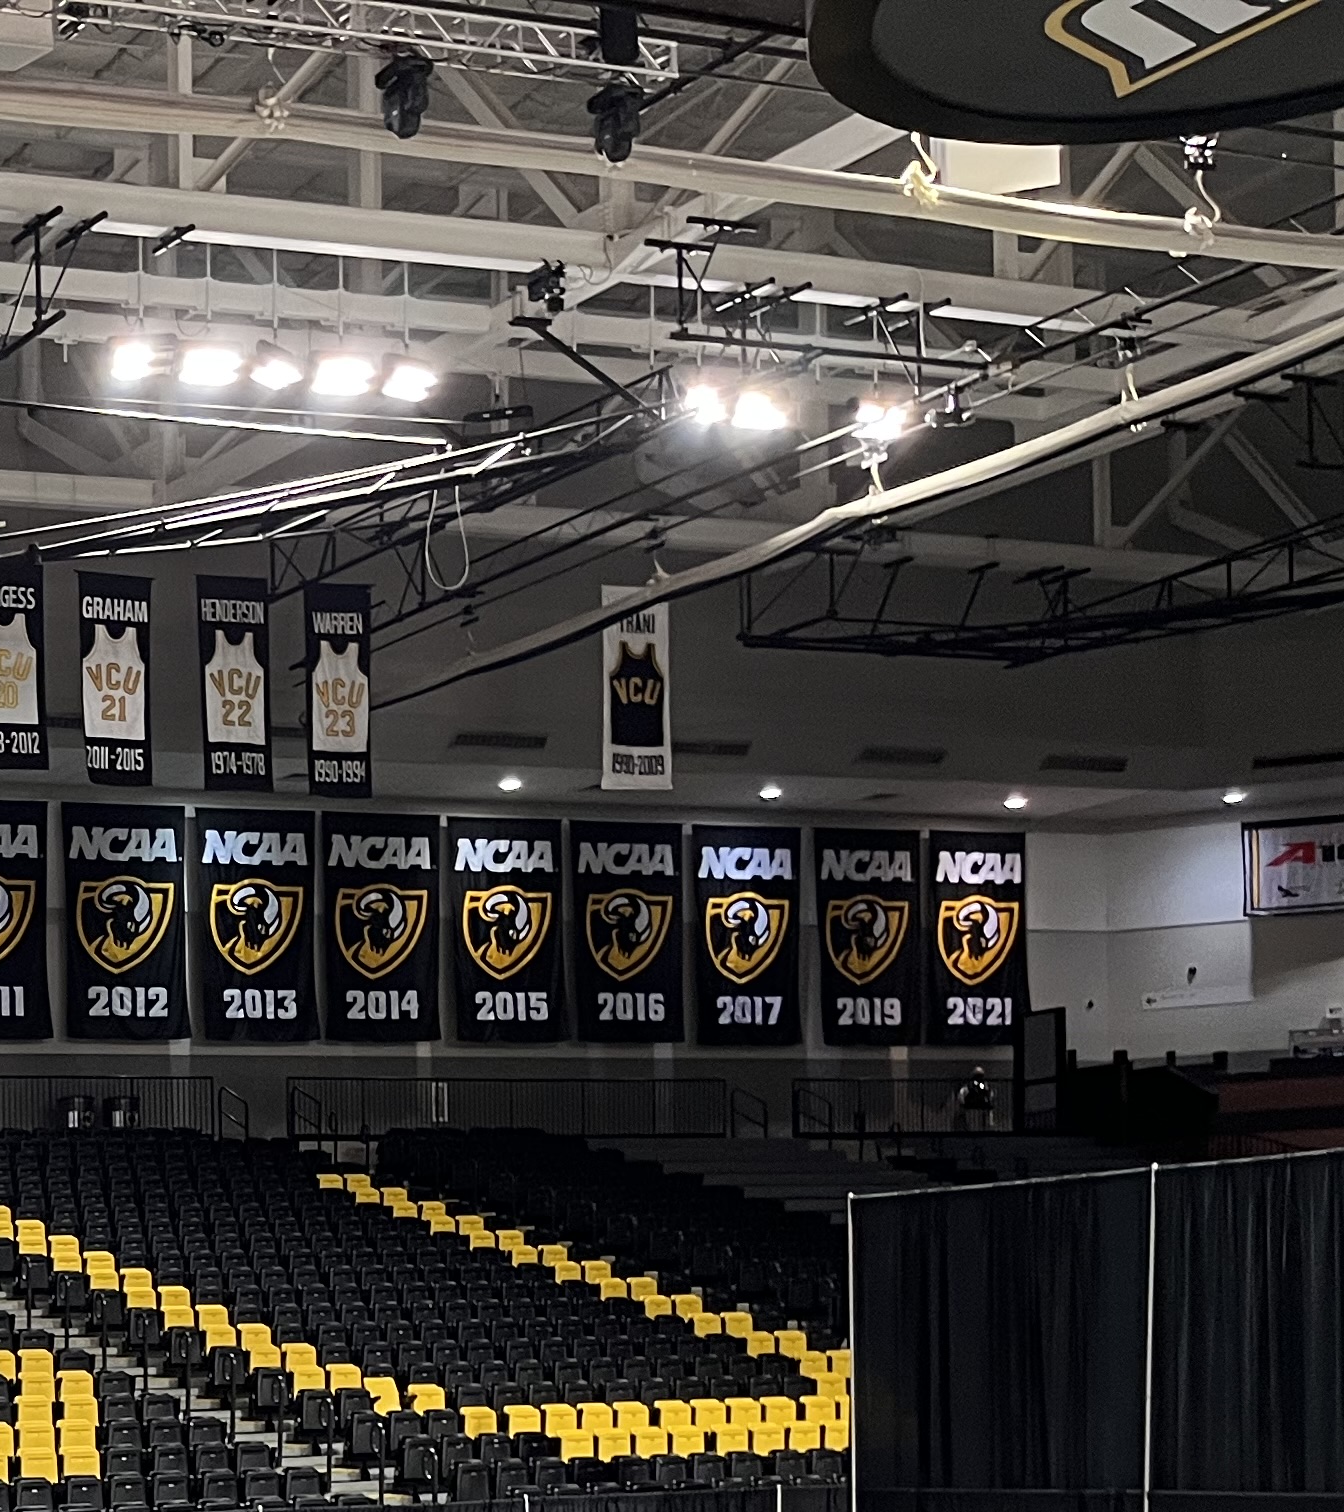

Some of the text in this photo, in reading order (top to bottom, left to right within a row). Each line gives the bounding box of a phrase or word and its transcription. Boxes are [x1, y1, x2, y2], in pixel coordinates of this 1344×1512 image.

[82, 595, 148, 622] GRAHAM
[201, 598, 264, 624] HENDERSON
[312, 611, 363, 634] WARREN
[86, 662, 141, 695] VCU
[209, 668, 261, 700] VCU
[315, 678, 365, 709] VCU
[613, 677, 661, 705] VCU
[101, 695, 127, 722] 21
[222, 700, 252, 727] 22
[325, 709, 356, 737] 23
[211, 751, 266, 775] 1974-1978
[69, 826, 178, 863] NCAA
[202, 829, 308, 866] NCAA
[327, 834, 431, 870] NCAA
[455, 837, 554, 872] NCAA
[578, 842, 674, 877] NCAA
[697, 846, 793, 880] NCAA
[821, 848, 912, 882] NCAA
[936, 850, 1022, 885] NCAA
[88, 986, 168, 1018] 2012
[223, 988, 298, 1019] 2013
[346, 989, 419, 1020] 2014
[475, 991, 549, 1022] 2015
[598, 992, 665, 1022] 2016
[717, 995, 783, 1026] 2017
[837, 996, 901, 1026] 2019
[946, 997, 1012, 1027] 2021
